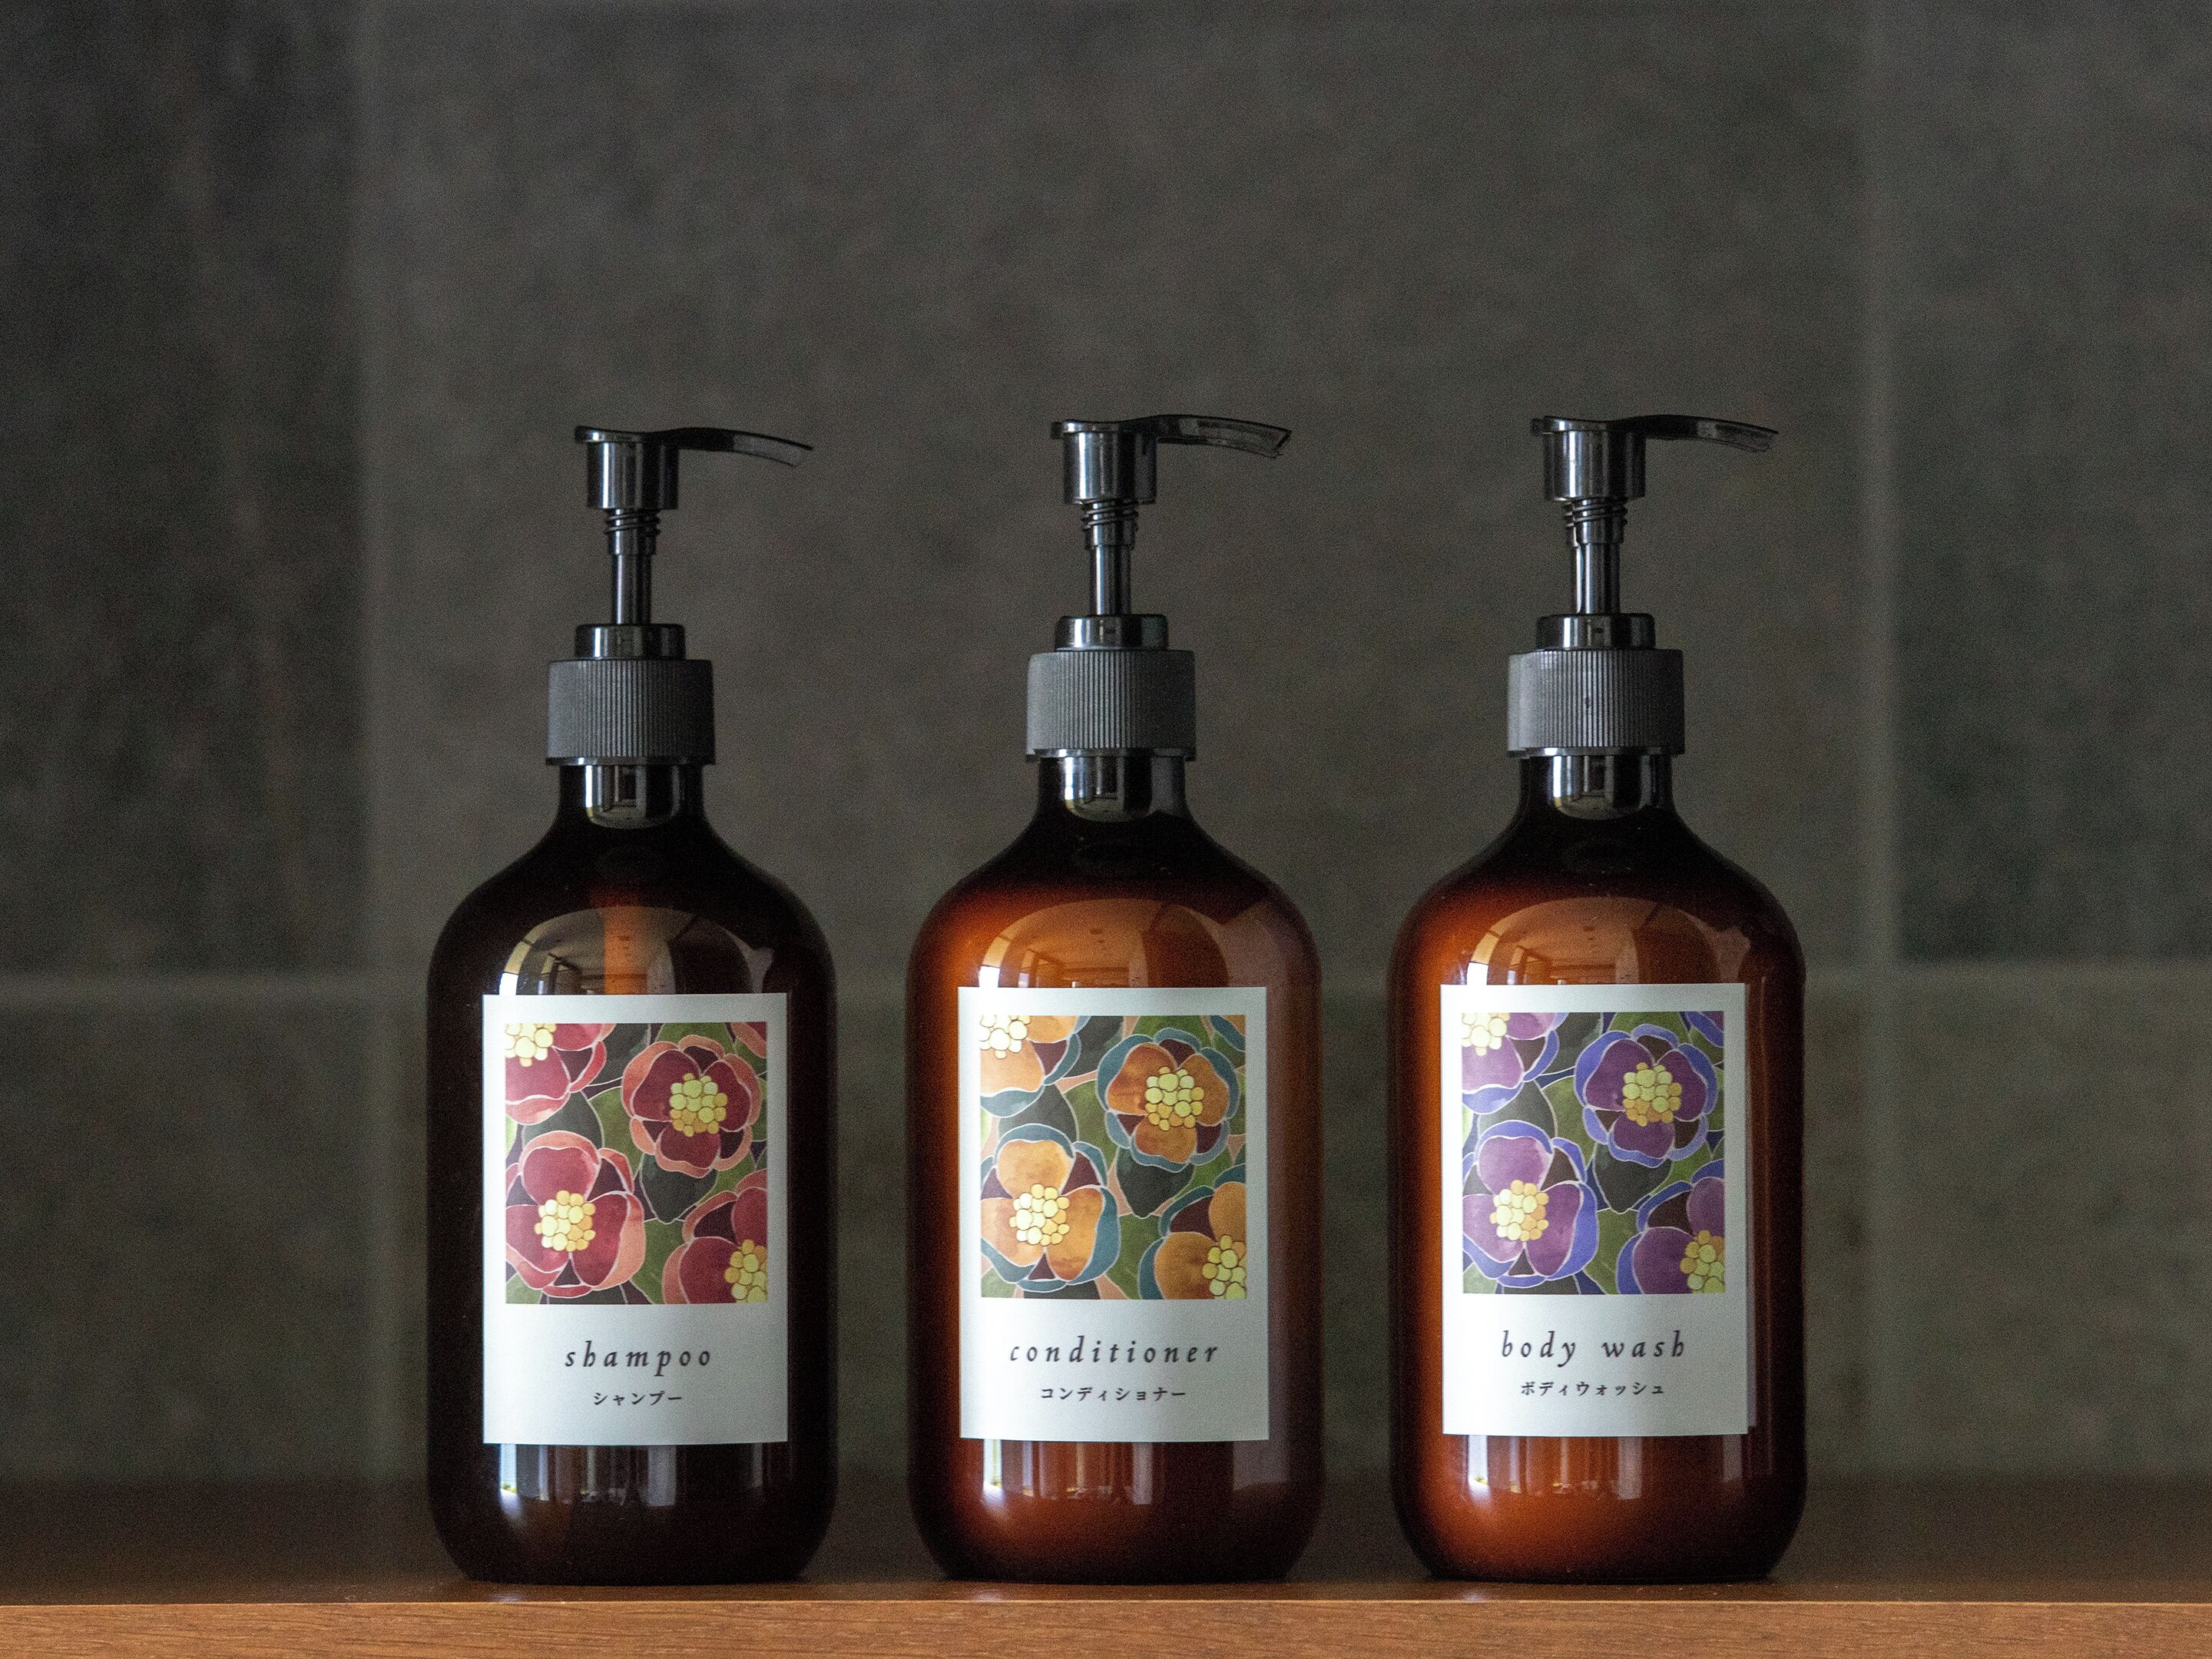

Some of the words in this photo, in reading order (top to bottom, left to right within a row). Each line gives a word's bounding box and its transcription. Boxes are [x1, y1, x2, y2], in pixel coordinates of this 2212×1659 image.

[565, 1339, 712, 1376] shampoo
[1009, 1335, 1219, 1363] conditioner
[1501, 1330, 1576, 1368] body
[1601, 1330, 1685, 1358] wash
[593, 1390, 683, 1406] シャンプー
[1041, 1386, 1187, 1402] コンディショナー
[1520, 1381, 1664, 1396] ボディウォッシュ
